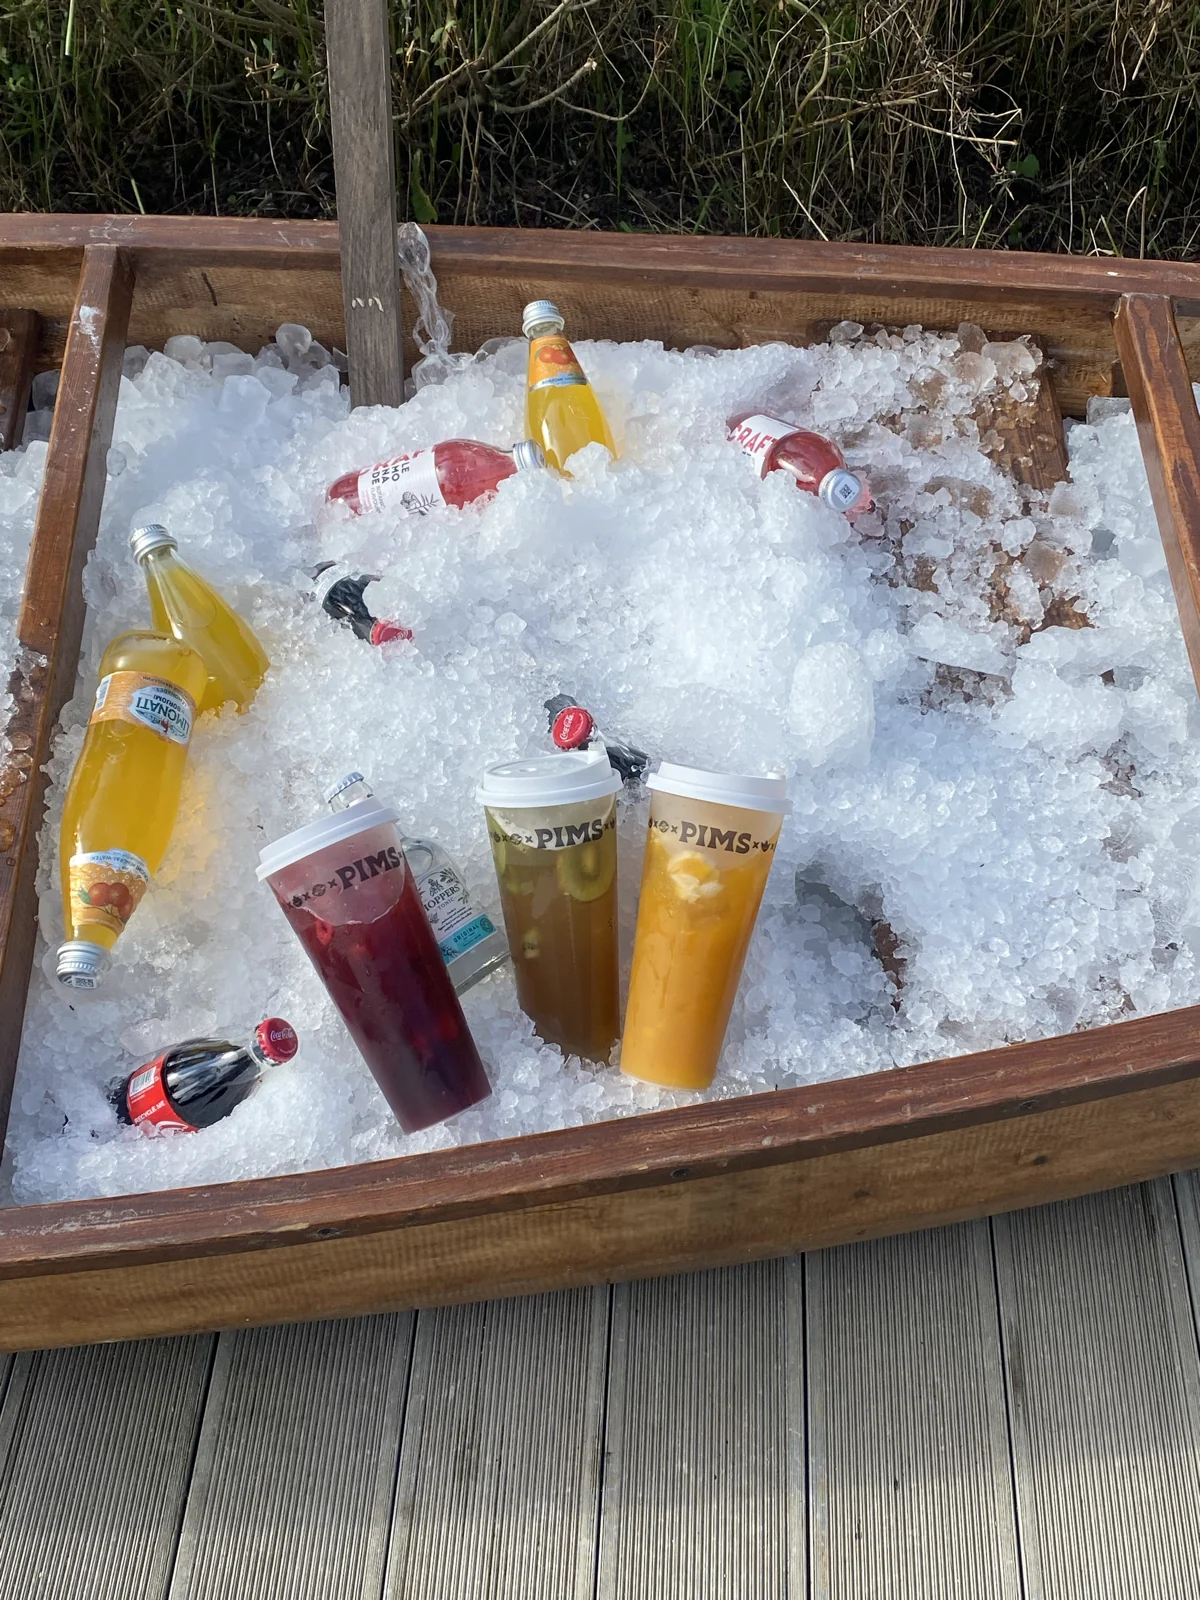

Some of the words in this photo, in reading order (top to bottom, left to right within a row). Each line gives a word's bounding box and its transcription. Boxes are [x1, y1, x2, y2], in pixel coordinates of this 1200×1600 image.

[381, 469, 390, 484] NA
[391, 465, 400, 482] MO
[401, 461, 410, 473] LE
[371, 471, 380, 485] DE
[136, 697, 190, 733] LIMONATI
[535, 818, 604, 849] PIMS
[679, 821, 752, 854] PIMS
[335, 846, 401, 890] PIMS
[438, 897, 455, 910] TONIC
[134, 1105, 158, 1124] RECYCLE
[154, 1100, 166, 1111] ME
